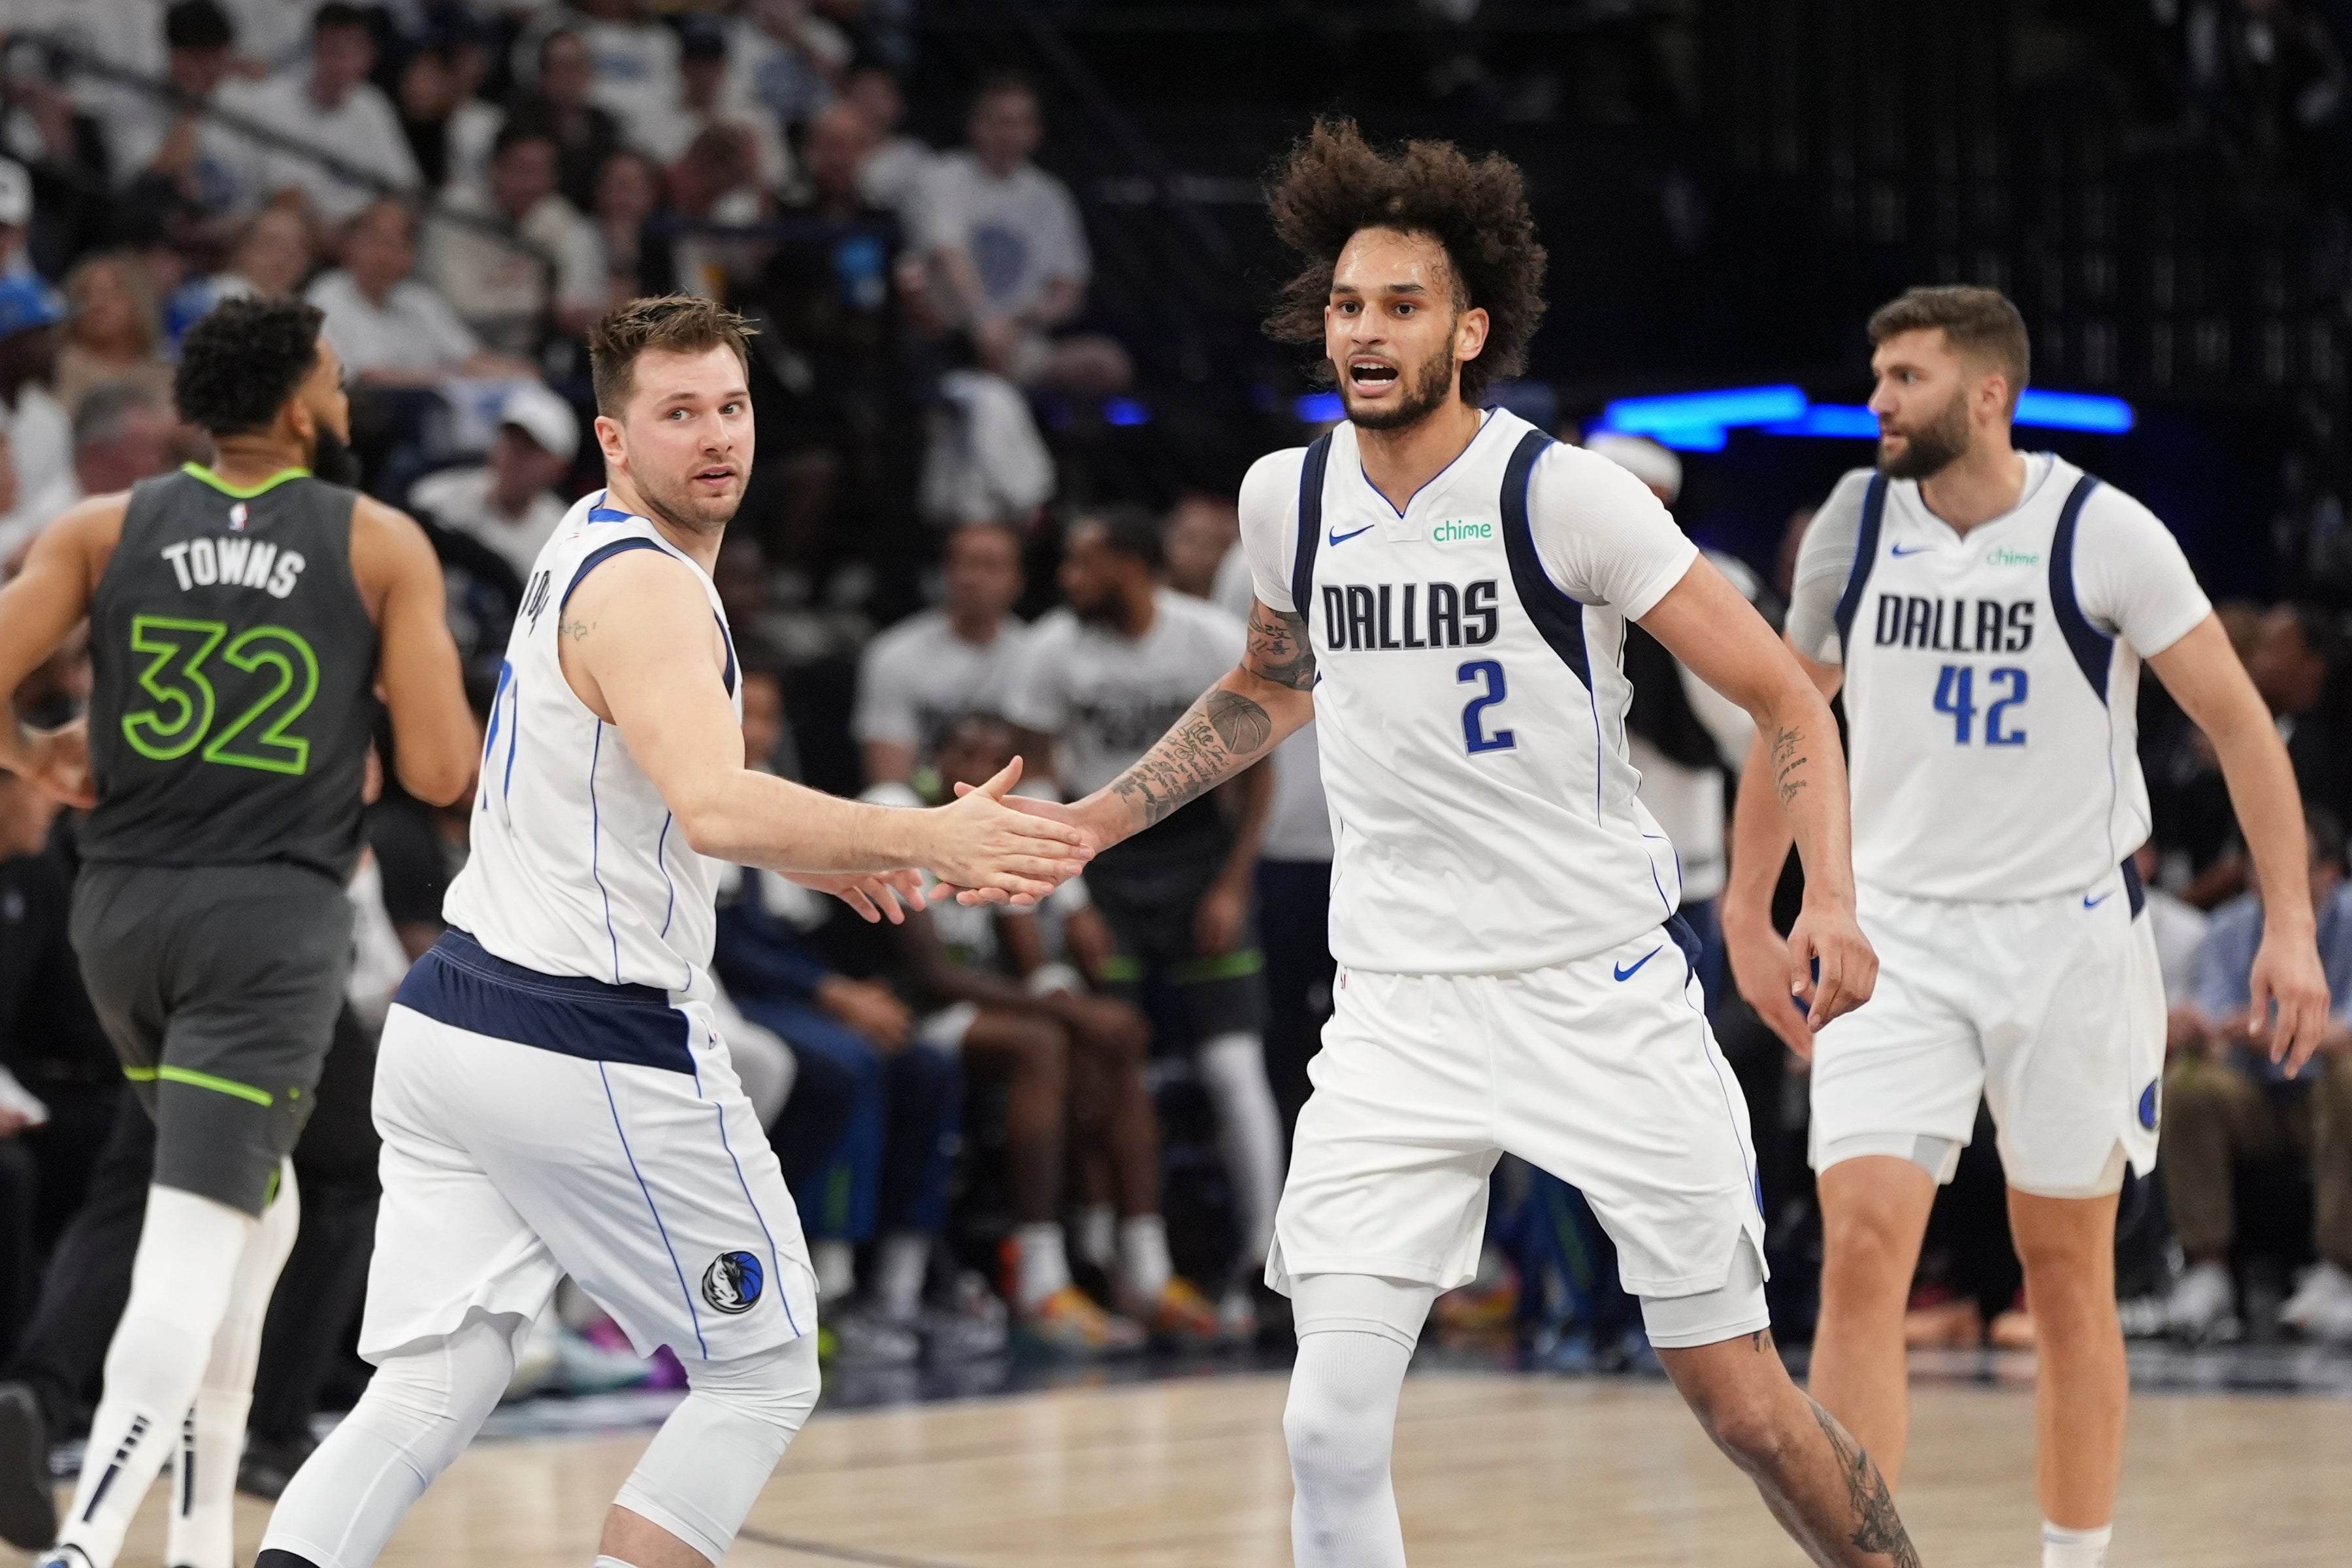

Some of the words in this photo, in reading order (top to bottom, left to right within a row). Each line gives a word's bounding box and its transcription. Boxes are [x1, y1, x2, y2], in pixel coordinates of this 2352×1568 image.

[1433, 520, 1492, 542] chime
[1986, 549, 2040, 566] chime
[161, 536, 306, 599] TOWNS
[1321, 579, 1499, 651] DALLAS
[1874, 594, 2035, 653] DALLAS
[121, 613, 320, 776] 32
[1456, 658, 1517, 757] 2
[1932, 664, 2029, 745] 42
